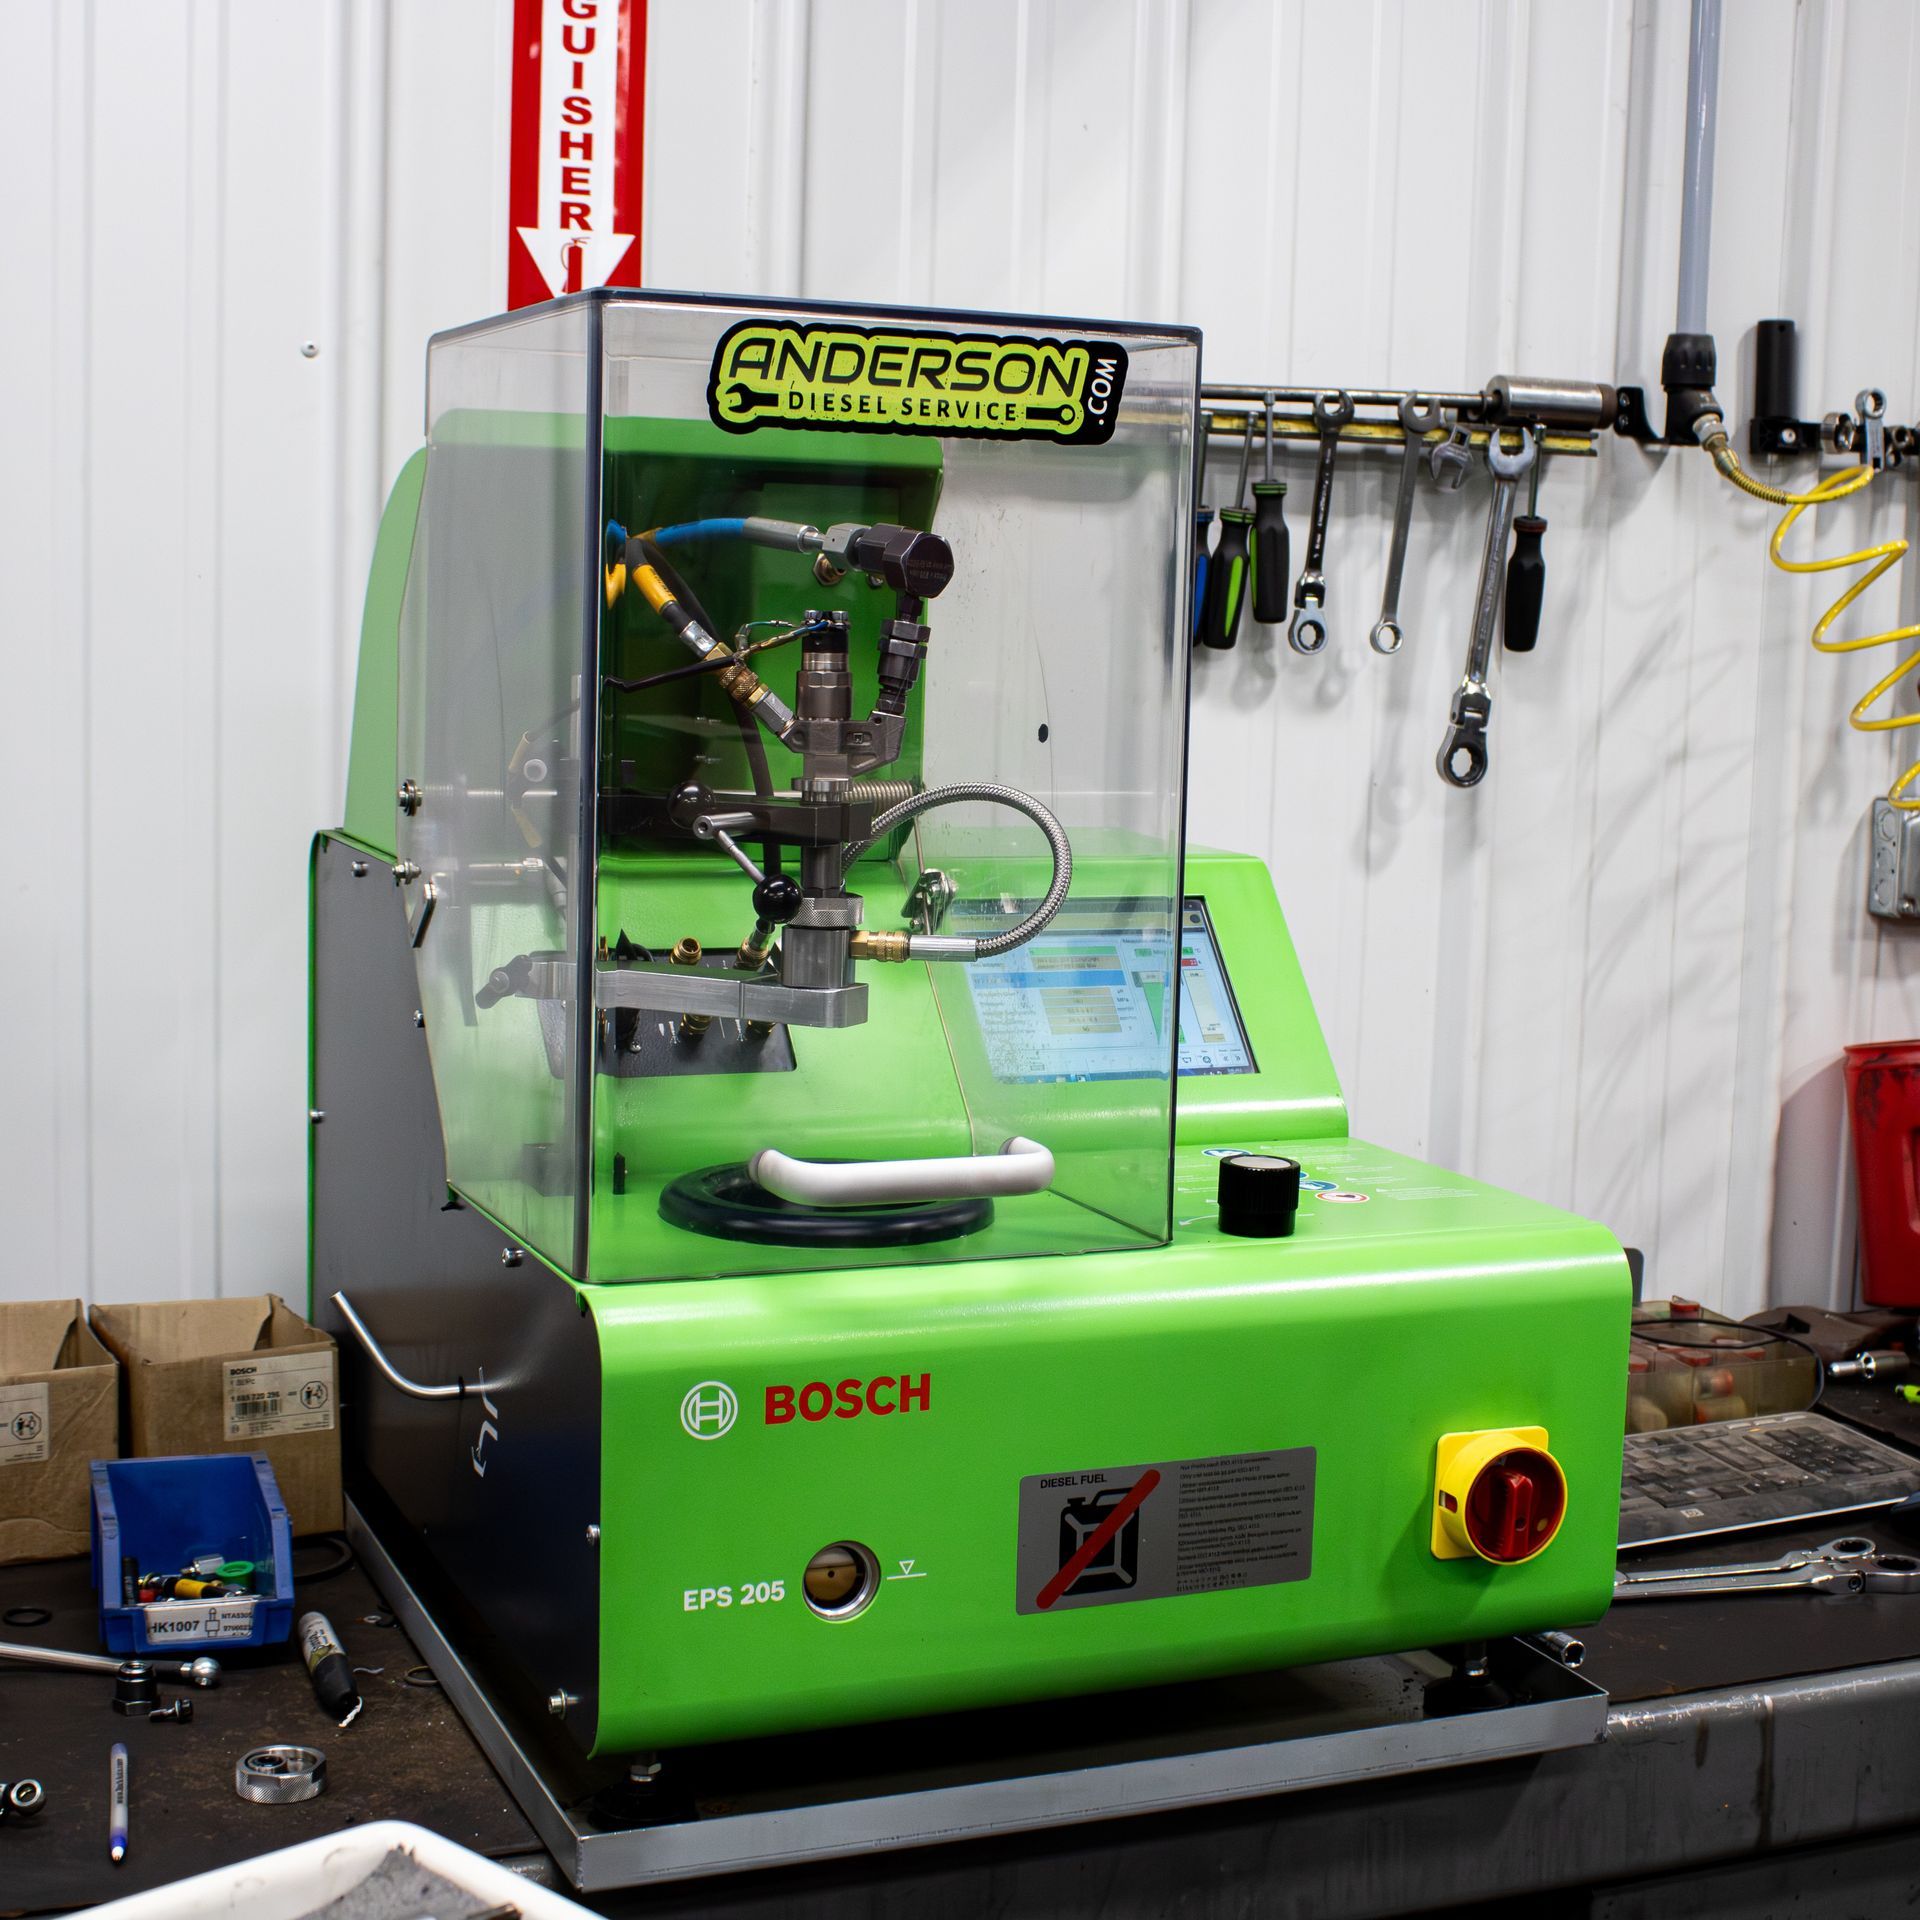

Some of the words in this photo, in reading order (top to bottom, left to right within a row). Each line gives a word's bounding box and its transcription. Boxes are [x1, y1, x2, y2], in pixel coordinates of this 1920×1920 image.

[728, 337, 1081, 397] ANDERSON
[788, 391, 888, 415] DIESEL
[901, 396, 1016, 421] SERVICE
[1087, 357, 1118, 426] .COM
[230, 1366, 257, 1376] BOSCH
[764, 1373, 931, 1425] BOSCH
[1040, 1475, 1078, 1489] DIESEL
[1080, 1473, 1107, 1486] FUEL
[684, 1586, 733, 1612] EPS
[740, 1580, 785, 1606] 205
